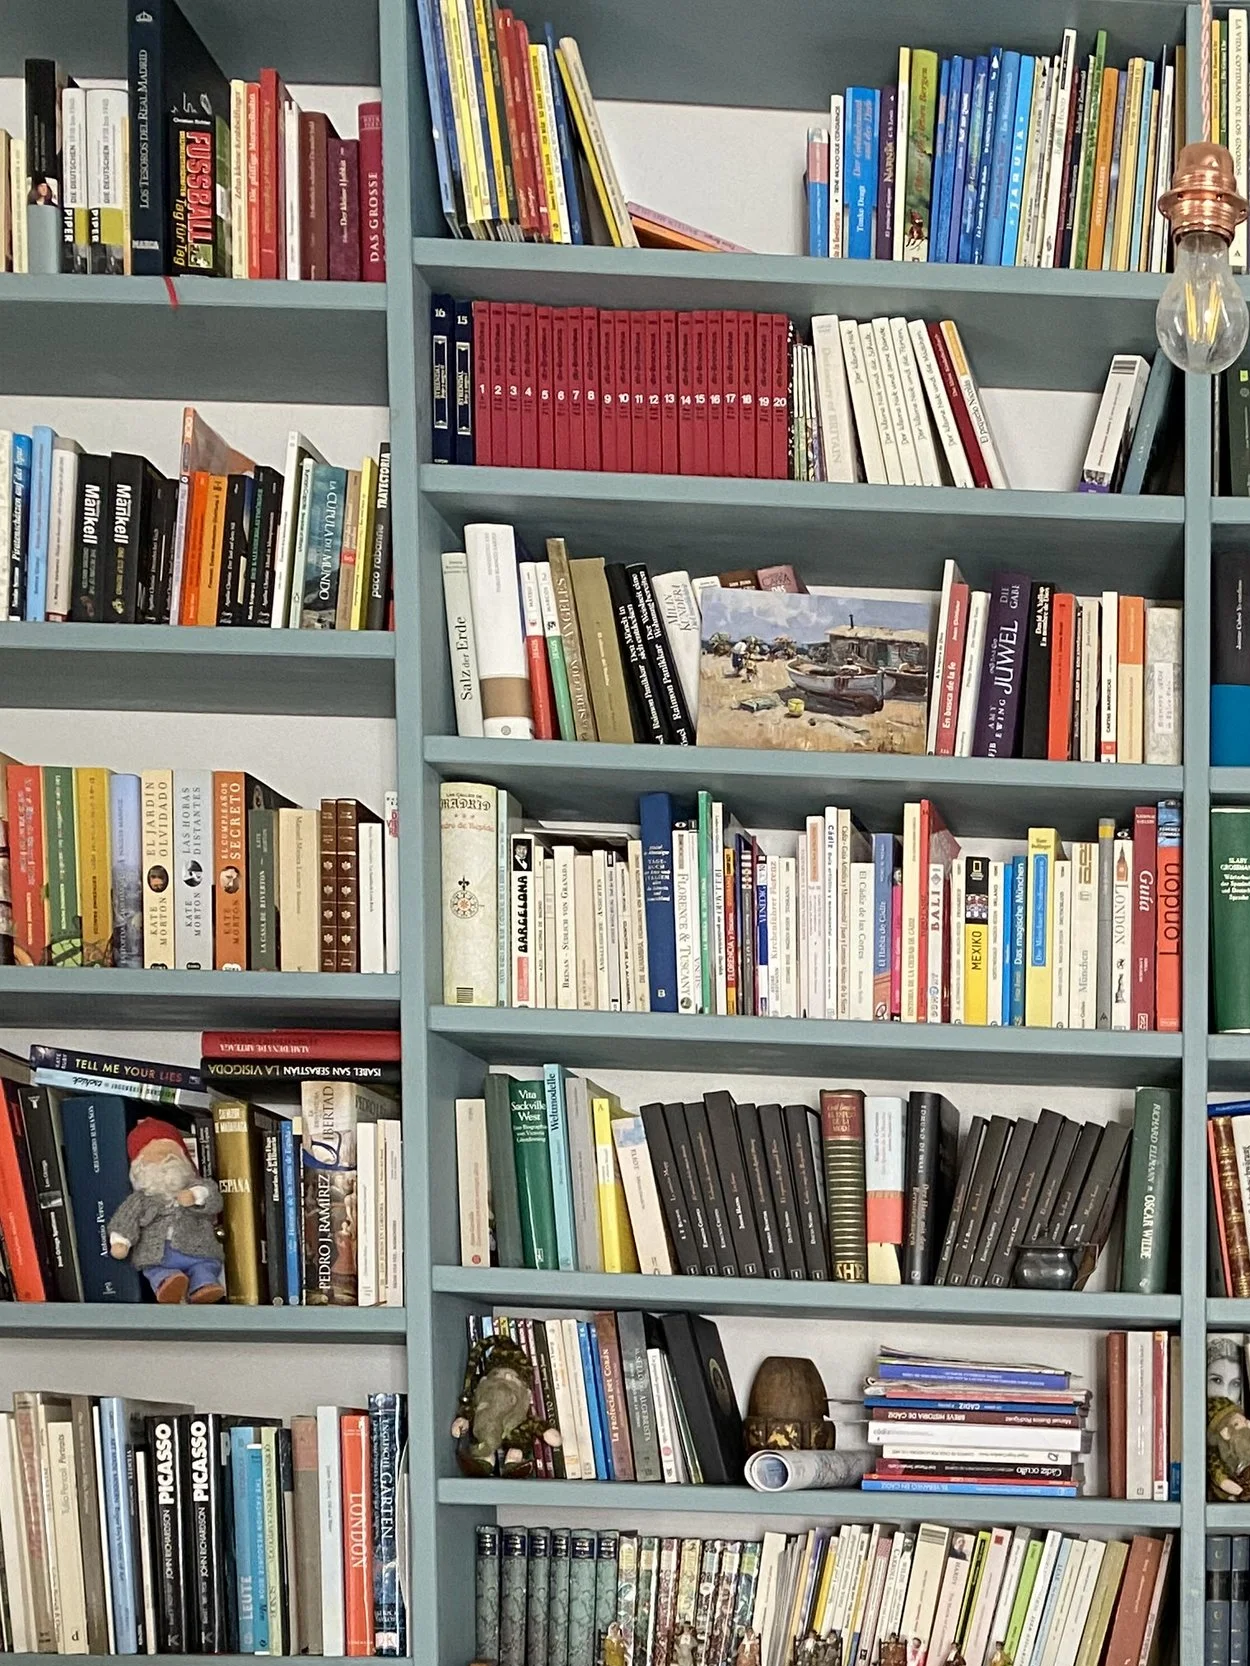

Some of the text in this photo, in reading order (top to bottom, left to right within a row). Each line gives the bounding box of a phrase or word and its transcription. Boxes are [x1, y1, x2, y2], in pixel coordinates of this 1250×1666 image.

[137, 50, 150, 208] LOS TESOROS DEL REAL MADRID
[69, 145, 77, 203] DIE DEUTSCHEN
[102, 145, 110, 203] DIE DEUTSCHEN
[186, 131, 214, 244] FUSSBALL
[173, 199, 186, 219] Tag
[368, 172, 379, 261] DAS GROSSE
[64, 207, 73, 242] PIPER
[91, 207, 100, 243] PIPER
[173, 243, 187, 265] Tag
[436, 309, 445, 317] 16
[457, 316, 468, 324] 15
[495, 385, 501, 394] 2
[511, 385, 517, 394] 3
[525, 387, 531, 396] 4
[542, 390, 548, 399] 5
[558, 391, 564, 400] 6
[573, 389, 579, 399] 7
[588, 390, 594, 399] 8
[604, 395, 611, 403] 9
[619, 393, 629, 403] 10
[635, 395, 643, 403] 11
[650, 395, 658, 404] 12
[665, 393, 674, 403] 13
[681, 396, 691, 405] 14
[695, 394, 705, 403] 15
[710, 395, 720, 404] 16
[726, 393, 735, 403] 17
[742, 394, 751, 403] 18
[759, 397, 769, 406] 19
[774, 398, 786, 407] 20
[377, 452, 391, 509] TRAYECTORIA
[82, 484, 101, 544] Mankell
[113, 484, 132, 543] Mankell
[318, 554, 333, 600] MUNDO
[456, 617, 473, 700] Salz der Erde
[994, 620, 1018, 695] JUWEL
[666, 686, 682, 720] Raimon
[944, 692, 953, 716] busca
[988, 706, 997, 728] AMY
[995, 698, 1006, 738] EWING
[987, 743, 998, 757] FJB
[159, 781, 168, 857] OLVIDADO
[441, 799, 491, 811] MADRID
[193, 787, 201, 854] DISTANTES
[229, 783, 241, 860] SECRETO
[678, 873, 690, 929] FLORENCE
[1139, 870, 1154, 911] Guía
[149, 906, 158, 936] KATE
[159, 897, 168, 945] MORTON
[517, 876, 528, 953] BARCELONA
[931, 890, 940, 931] BALI
[1014, 863, 1025, 965] Das magische München
[1114, 884, 1129, 945] LONDON
[1159, 863, 1180, 956] London
[971, 931, 982, 970] MEXIKO
[679, 948, 692, 995] TUSCANY
[74, 1058, 98, 1071] TELL
[103, 1061, 120, 1074] ME
[124, 1064, 156, 1079] YOUR
[208, 1064, 262, 1076] VISIGODA
[264, 1065, 280, 1076] LA
[333, 1067, 350, 1075] SAN
[354, 1067, 381, 1077] ISABEL
[511, 1101, 546, 1111] Sackville
[518, 1090, 537, 1098] Vita
[547, 1073, 559, 1131] Weltmodelle
[518, 1112, 541, 1121] West
[1149, 1102, 1161, 1143] RICHARD
[1143, 1194, 1155, 1226] OSCAR
[1140, 1229, 1153, 1259] WILDE
[319, 1246, 330, 1290] PEDRO
[156, 1424, 174, 1505] PICASSO
[190, 1422, 209, 1502] PICASSO
[350, 1492, 367, 1567] LONDON
[164, 1559, 174, 1580] JOHN
[199, 1557, 208, 1578] JOHN
[240, 1576, 252, 1619] LEUTE
